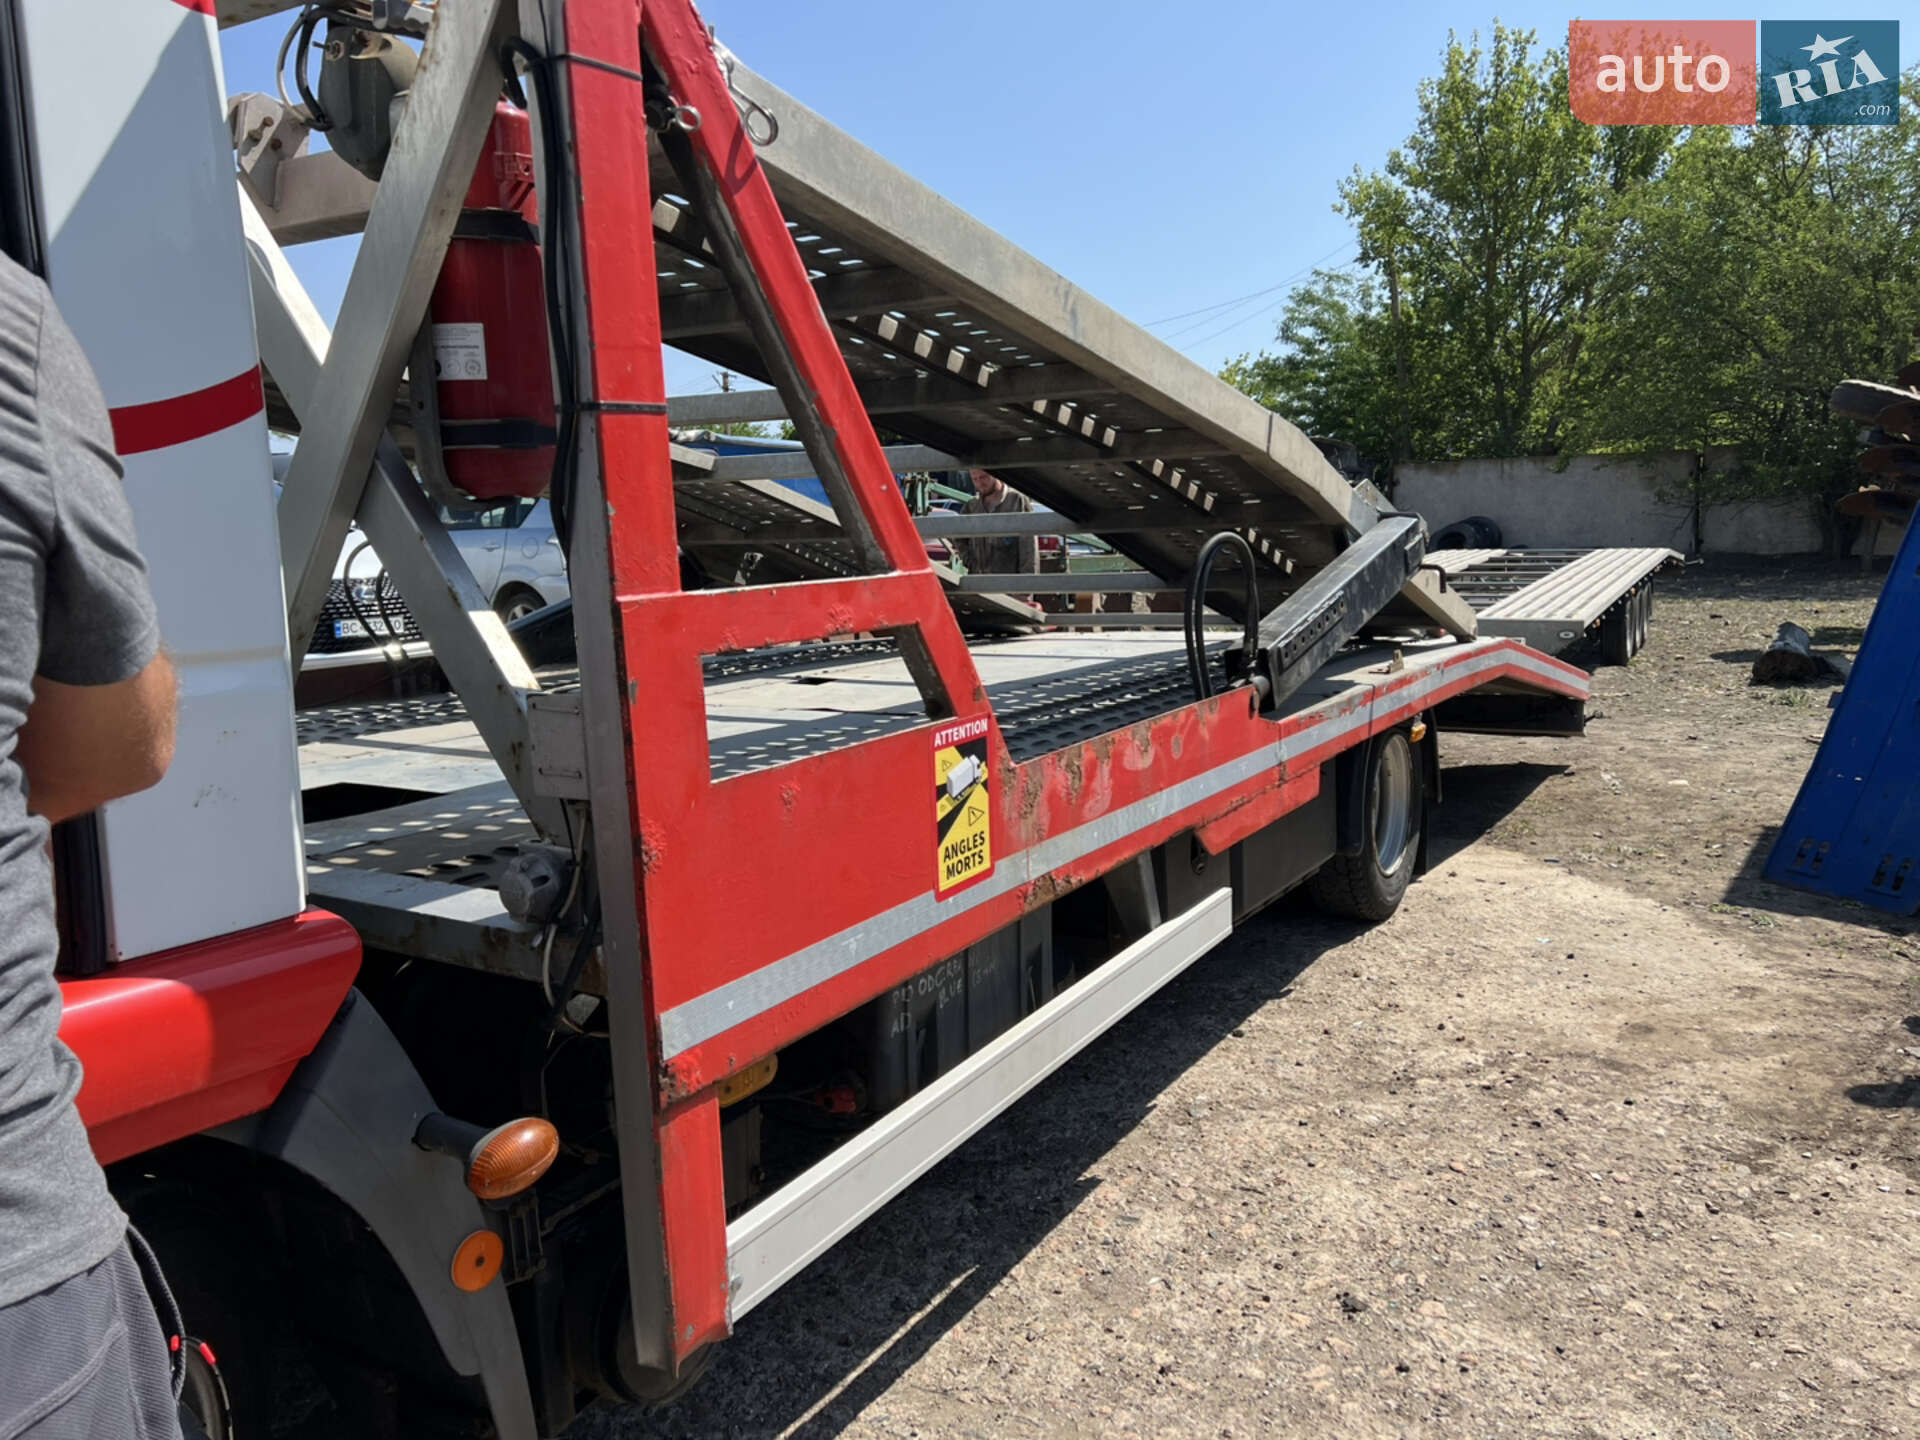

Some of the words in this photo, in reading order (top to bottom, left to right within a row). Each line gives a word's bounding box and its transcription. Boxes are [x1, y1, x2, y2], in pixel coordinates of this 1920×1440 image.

[934, 718, 988, 747] ATTENTION
[943, 830, 985, 862] ANGLES
[946, 849, 984, 880] MORTS
